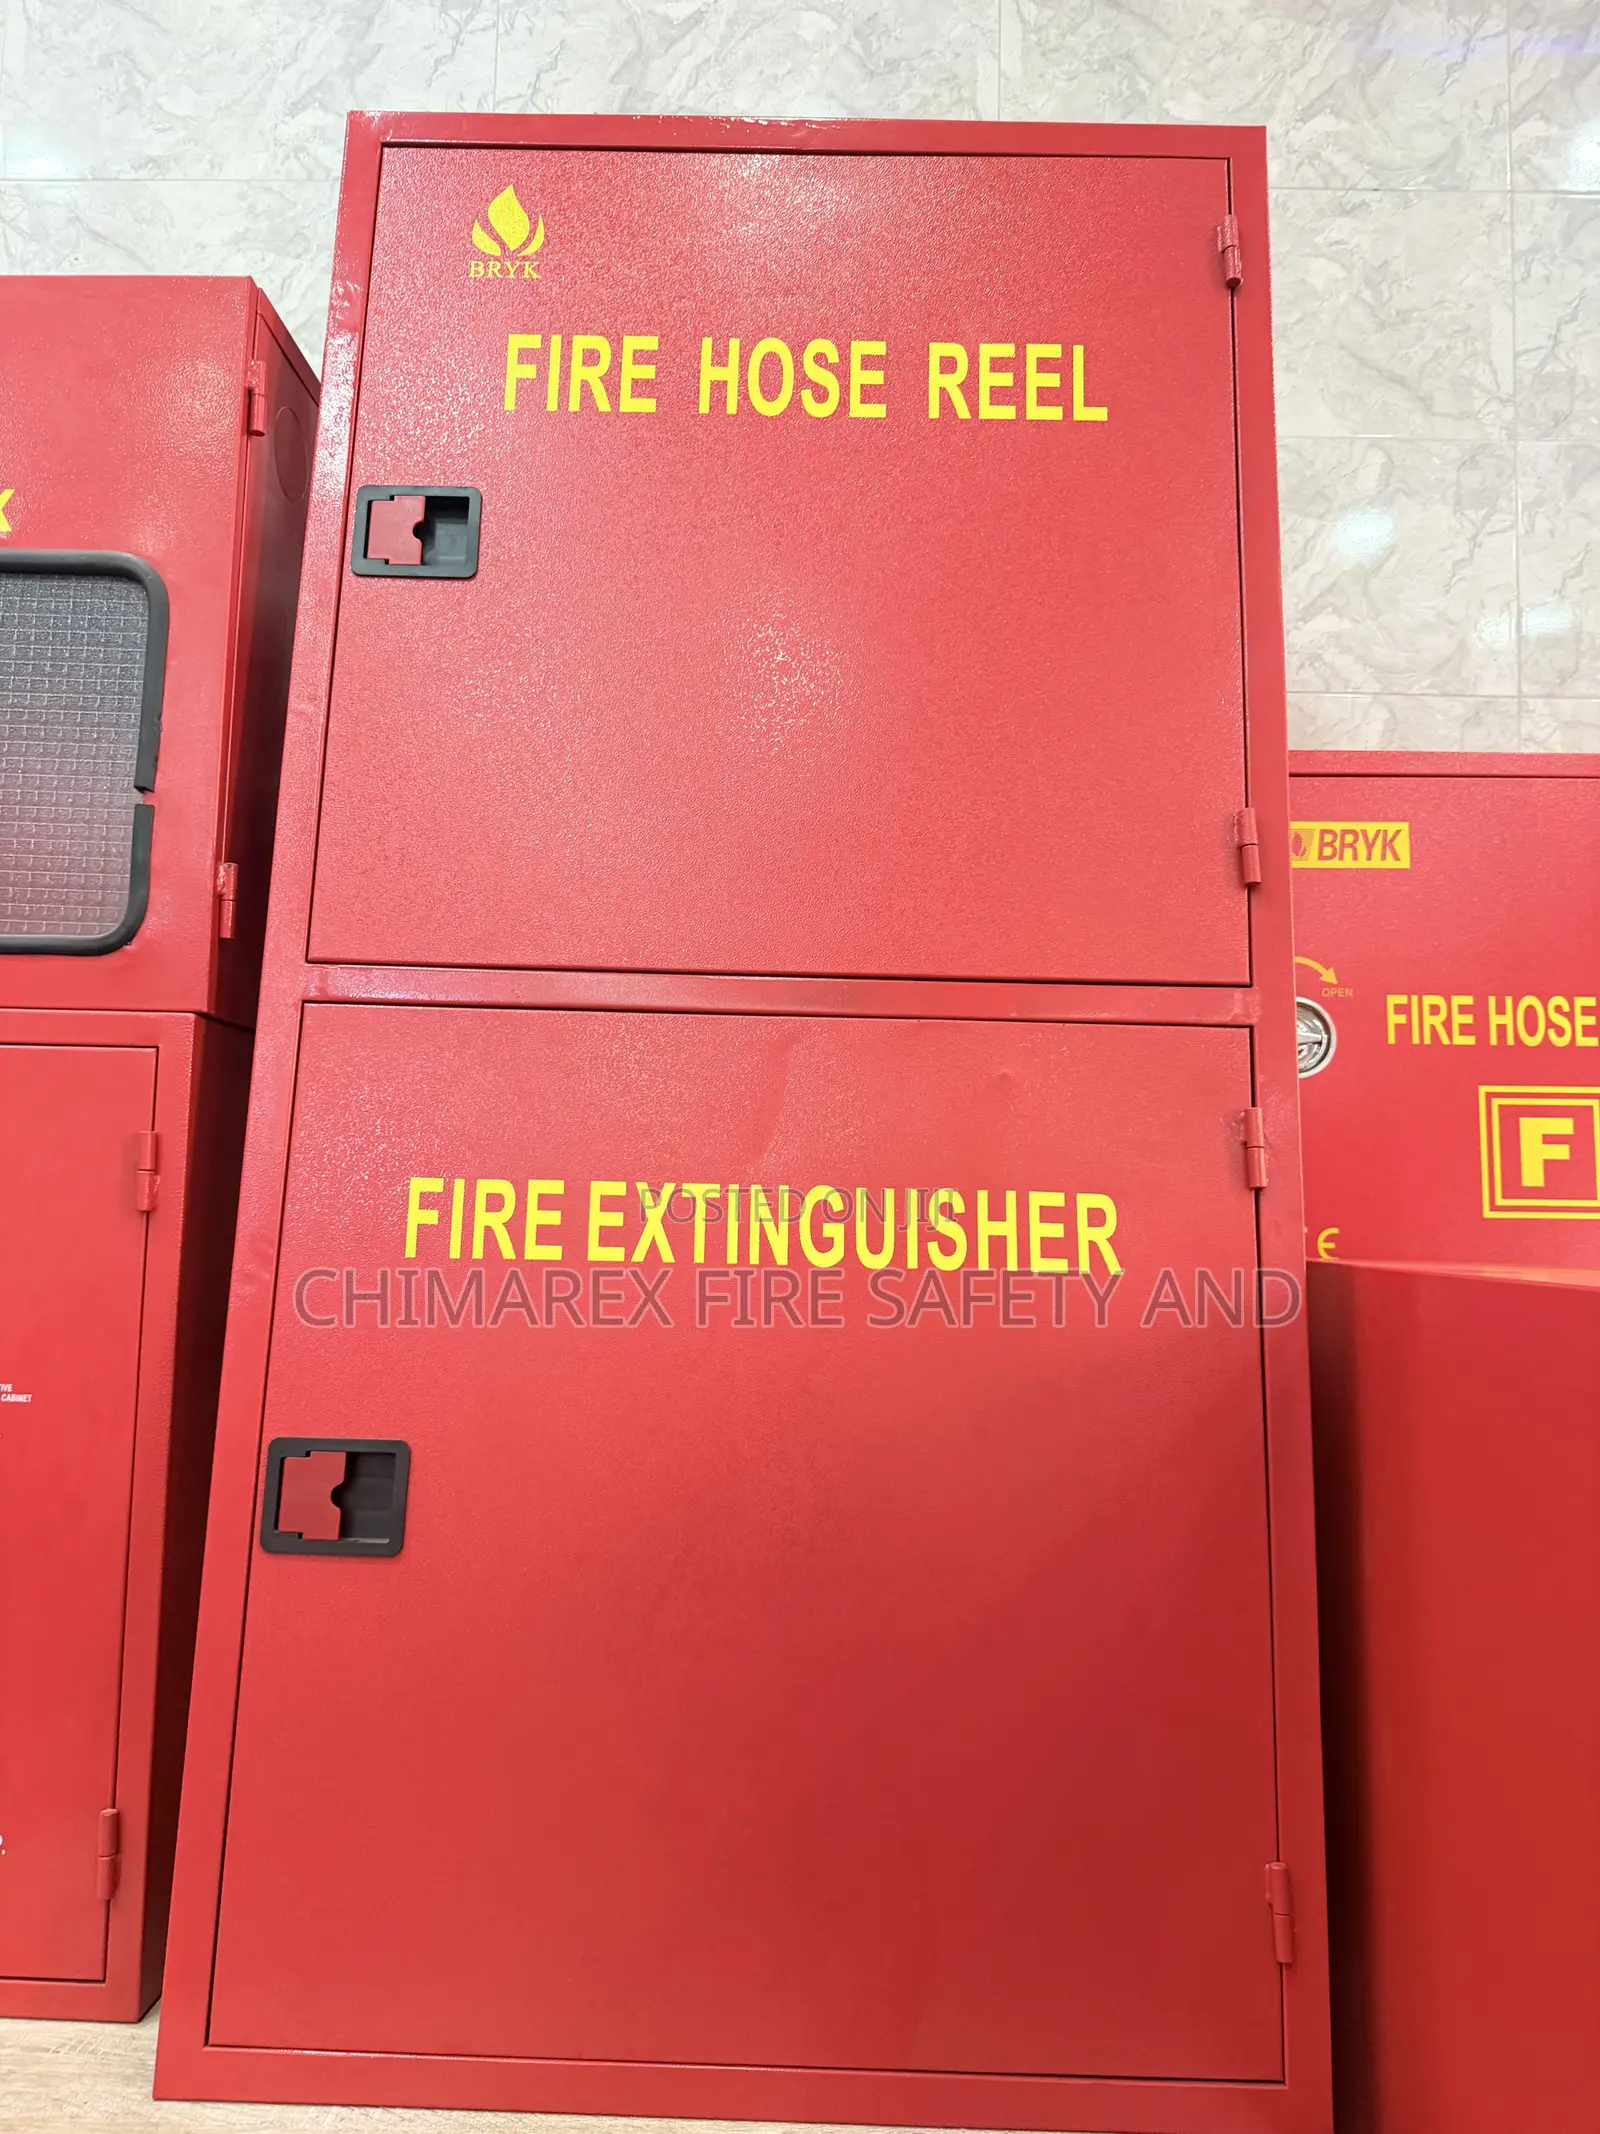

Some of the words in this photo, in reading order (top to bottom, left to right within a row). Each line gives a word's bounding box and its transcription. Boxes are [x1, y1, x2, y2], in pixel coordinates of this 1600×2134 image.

[468, 260, 541, 280] BRYK
[503, 332, 661, 416] FIRE
[697, 336, 888, 420] HOSE
[926, 341, 1110, 422] REEL
[1317, 828, 1403, 862] BRYK
[1321, 987, 1354, 998] OPEN
[1386, 994, 1476, 1046] FIRE
[1488, 995, 1599, 1048] HOSE
[404, 1176, 565, 1262] FIRE
[586, 1178, 1124, 1277] EXTINGUISHER
[1, 1393, 33, 1403] CABINET
